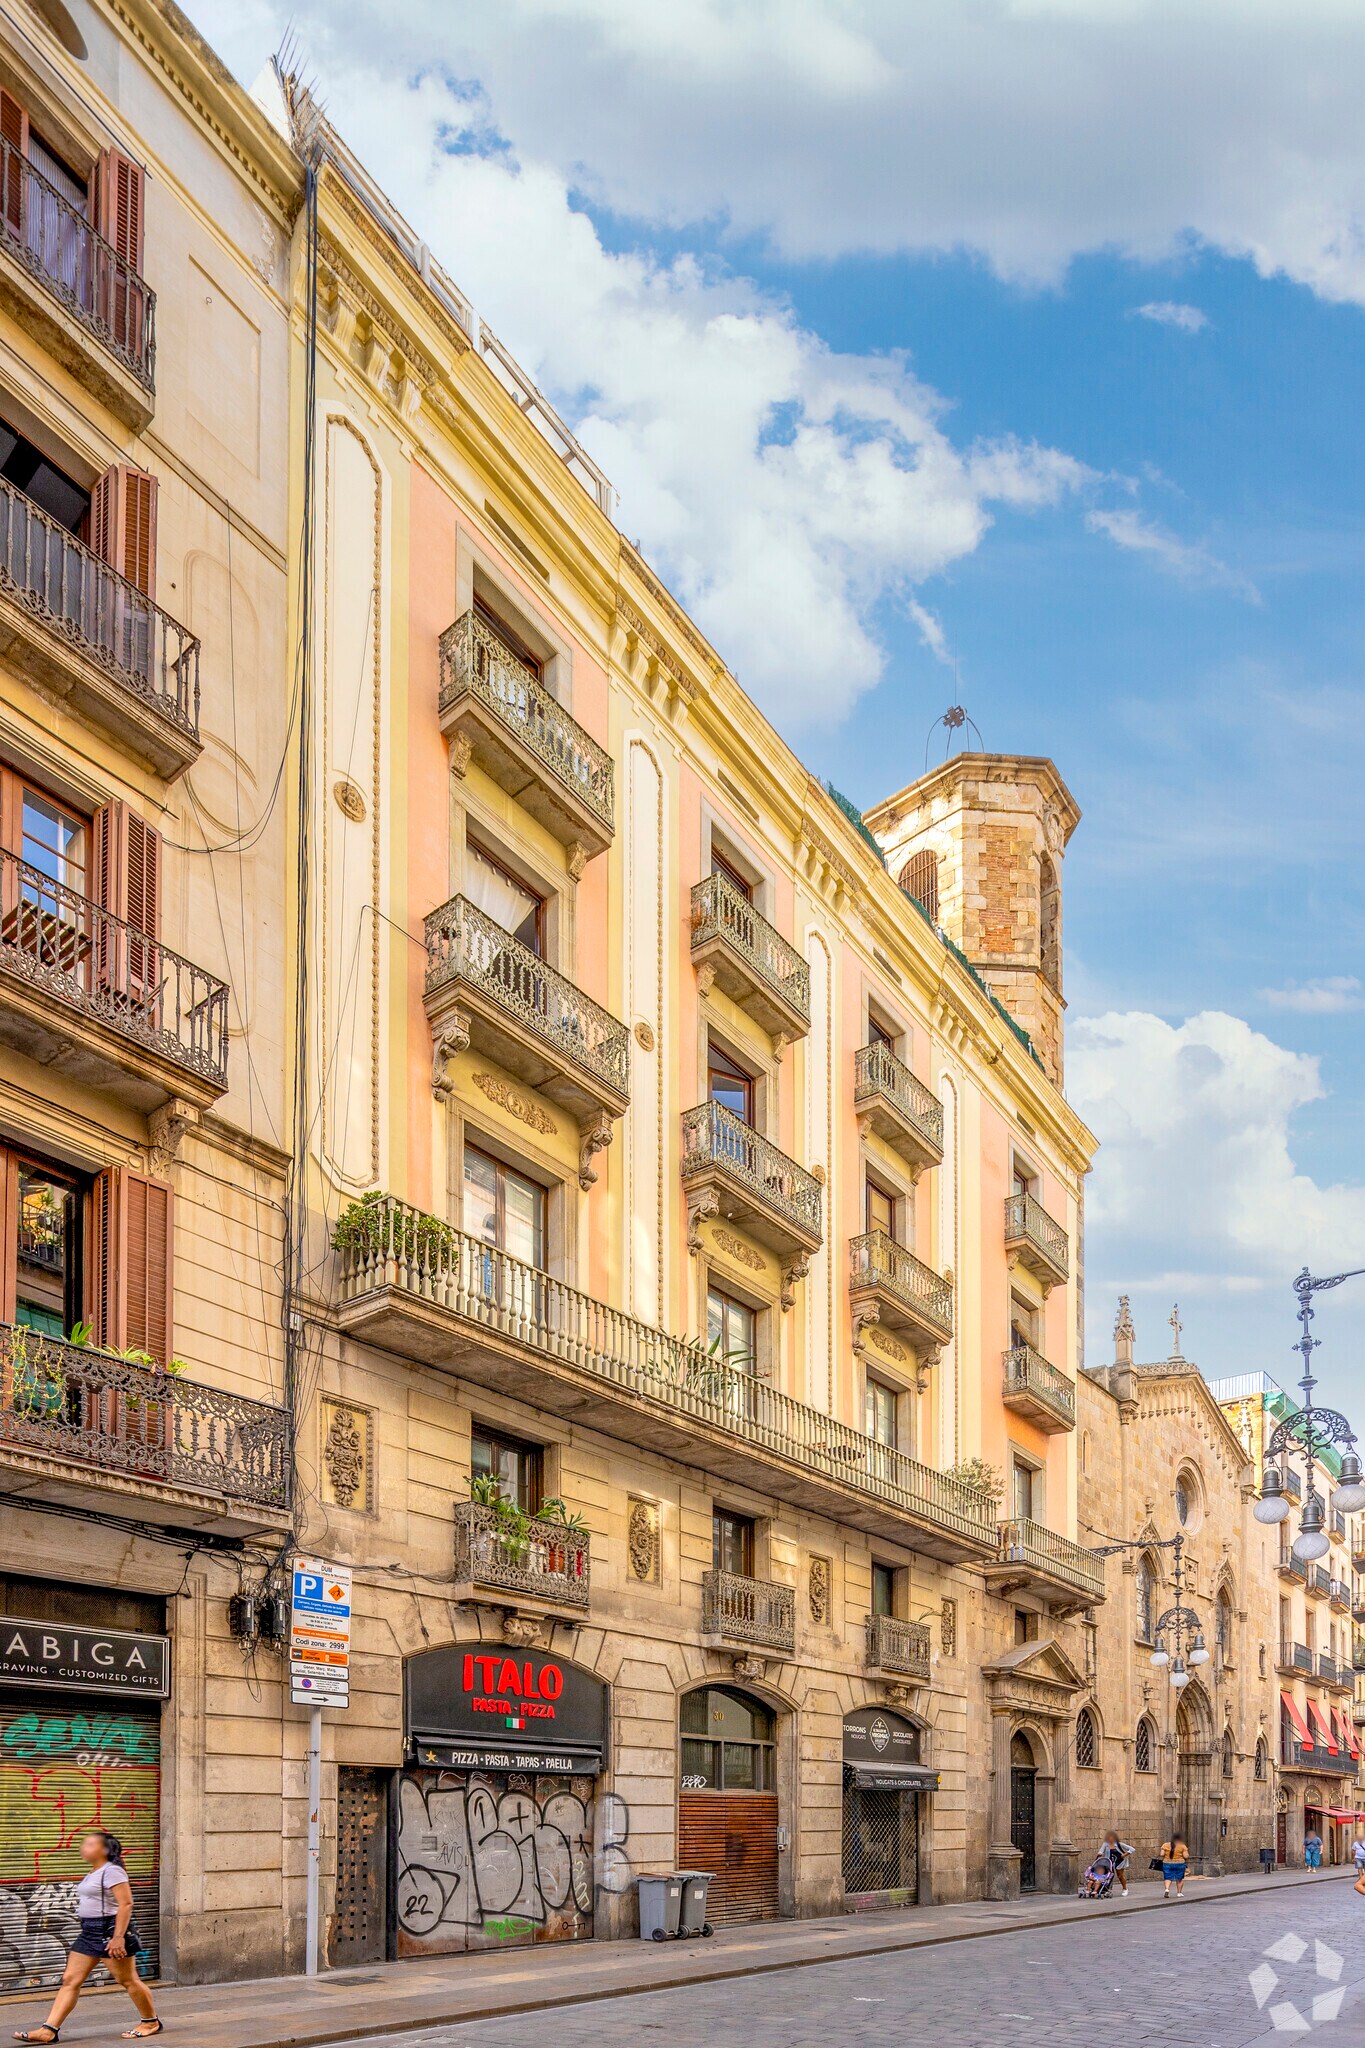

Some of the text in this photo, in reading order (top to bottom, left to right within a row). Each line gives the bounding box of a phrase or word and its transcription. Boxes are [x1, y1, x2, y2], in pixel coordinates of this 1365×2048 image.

[301, 1575, 317, 1595] P
[5, 1632, 146, 1669] ABIGA
[329, 1641, 345, 1650] 2999
[58, 1668, 128, 1682] CUSTOMIZED
[131, 1675, 159, 1685] GIFTS
[463, 1653, 564, 1700] ITALO
[472, 1697, 556, 1719] PASTA PIZZA
[713, 1711, 725, 1722] 30
[843, 1724, 867, 1734] TORRONS
[452, 1752, 573, 1770] PIZZA PASTA TAPAS PAELLA
